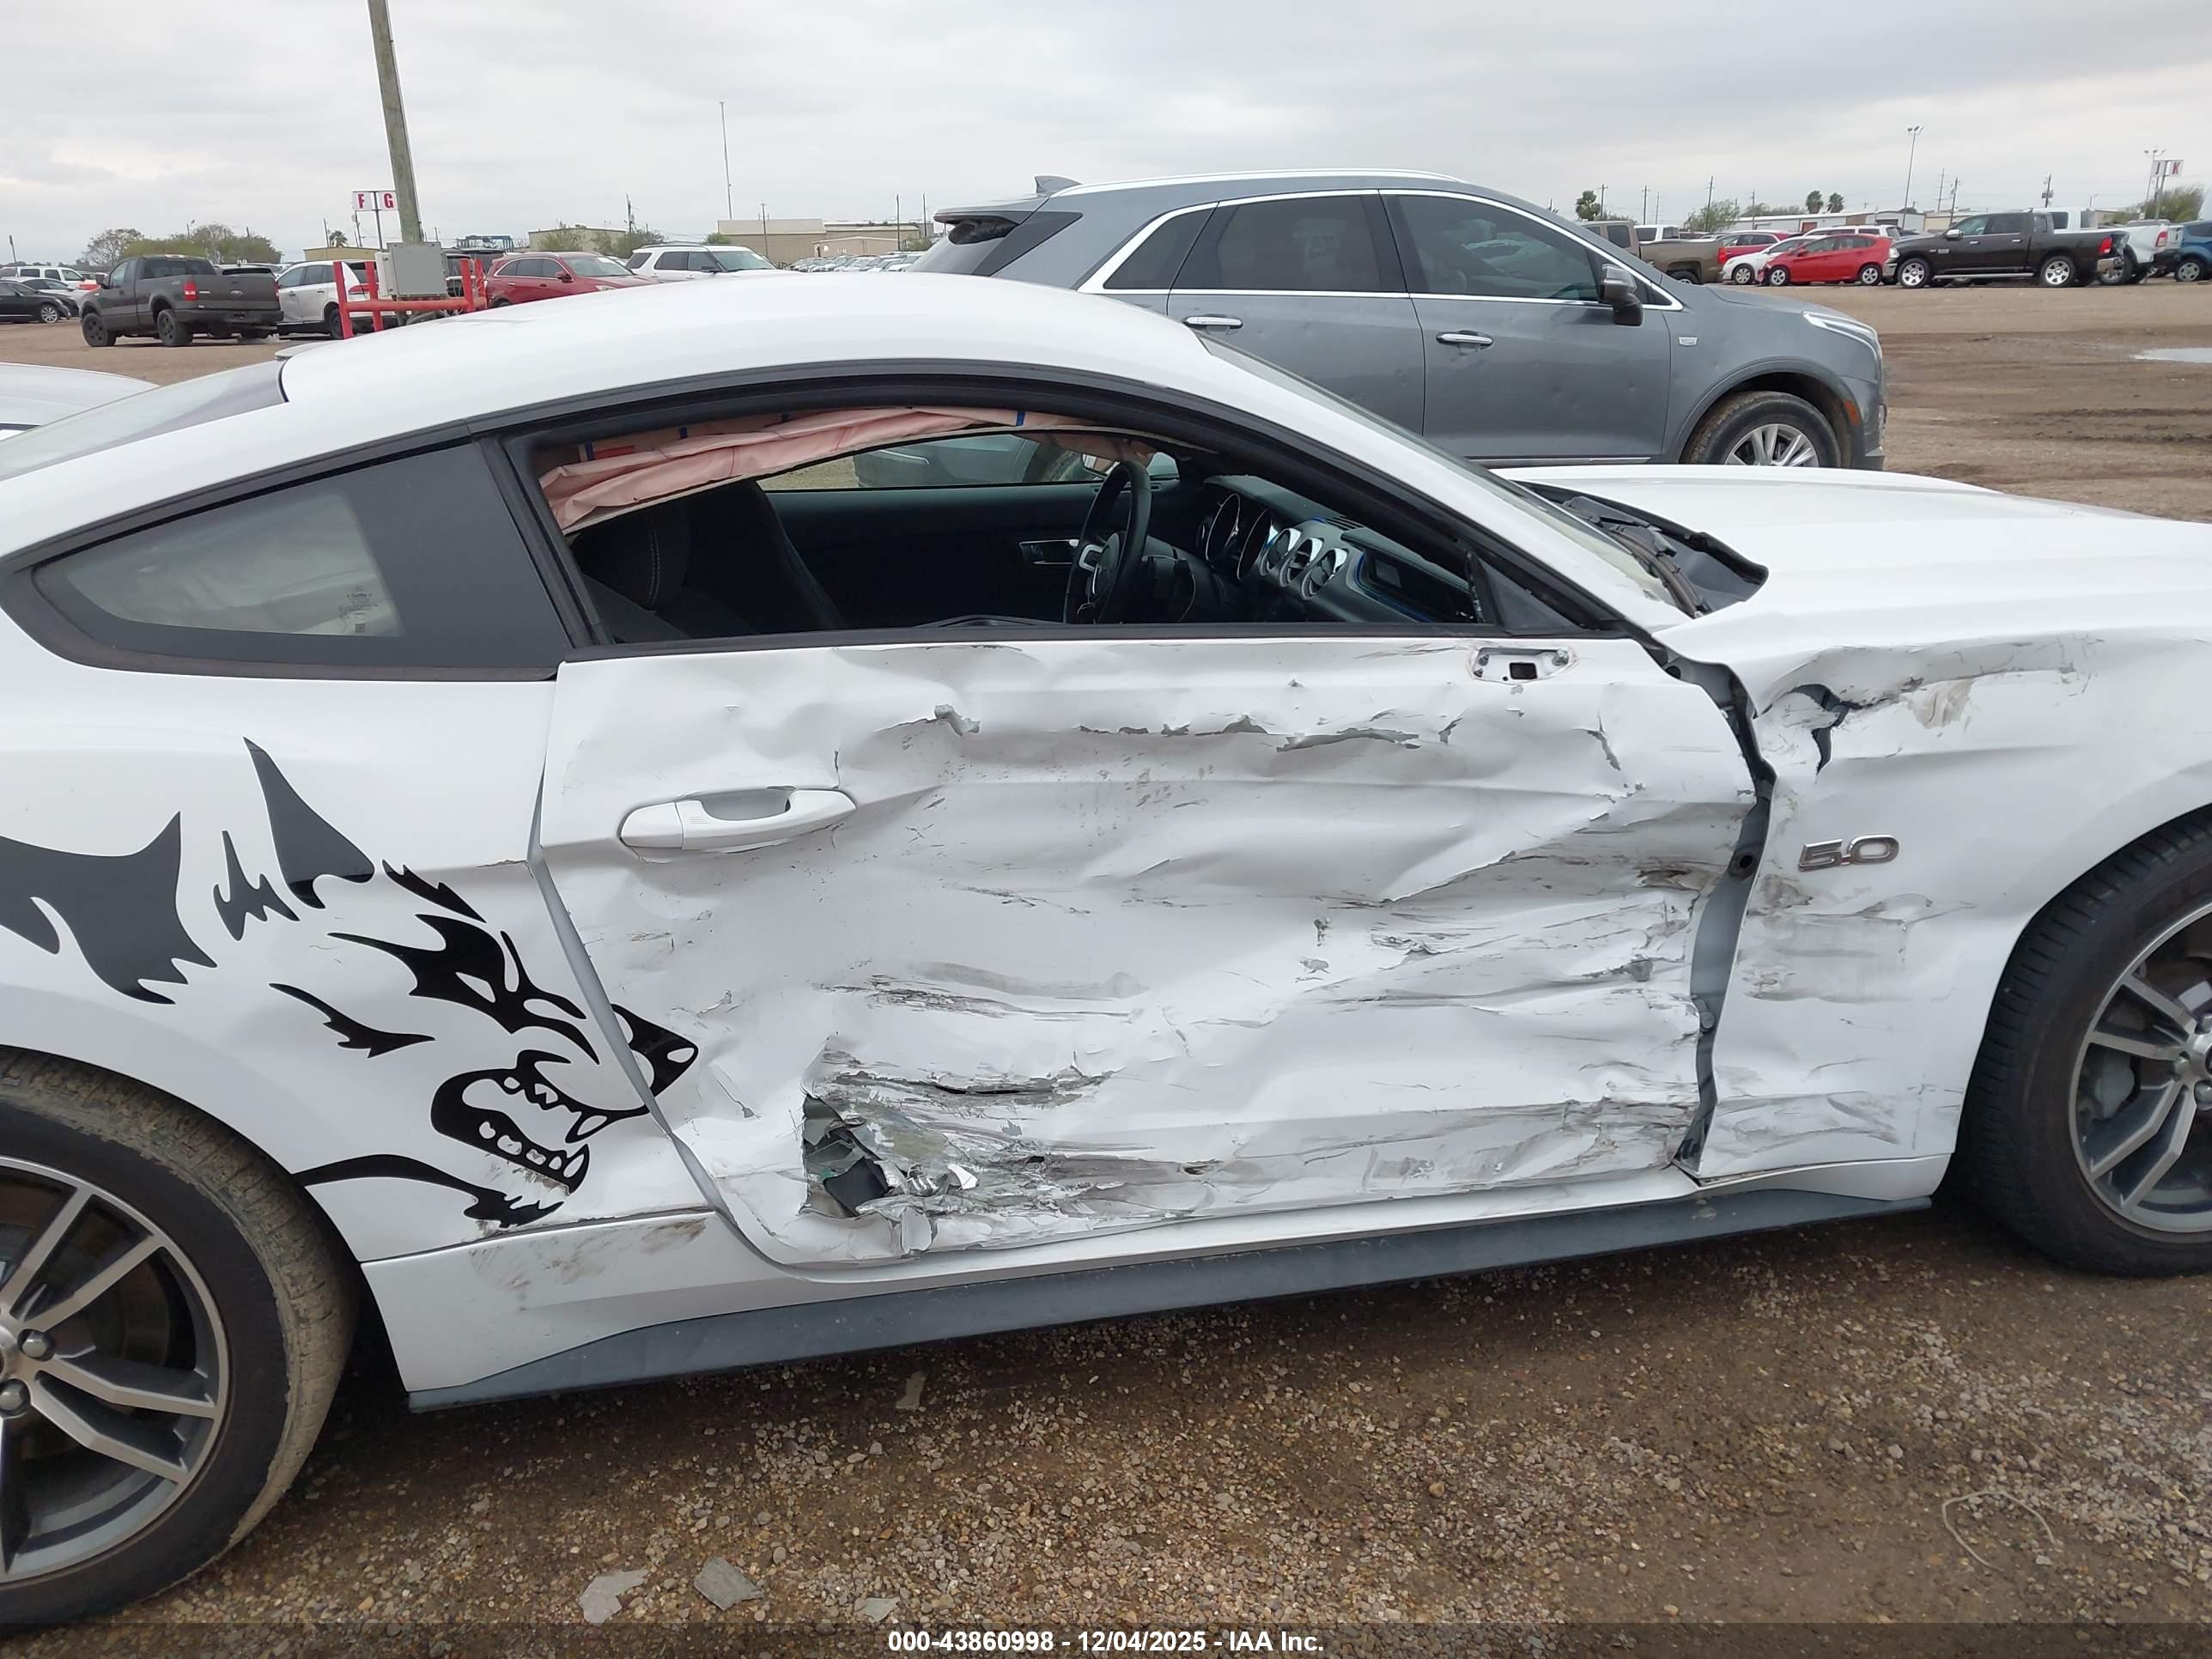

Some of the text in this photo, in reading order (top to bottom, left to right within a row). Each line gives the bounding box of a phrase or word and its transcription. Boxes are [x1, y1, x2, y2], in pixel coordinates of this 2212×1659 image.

[357, 193, 365, 209] F
[383, 192, 394, 209] G
[1799, 834, 1899, 872] 5.0
